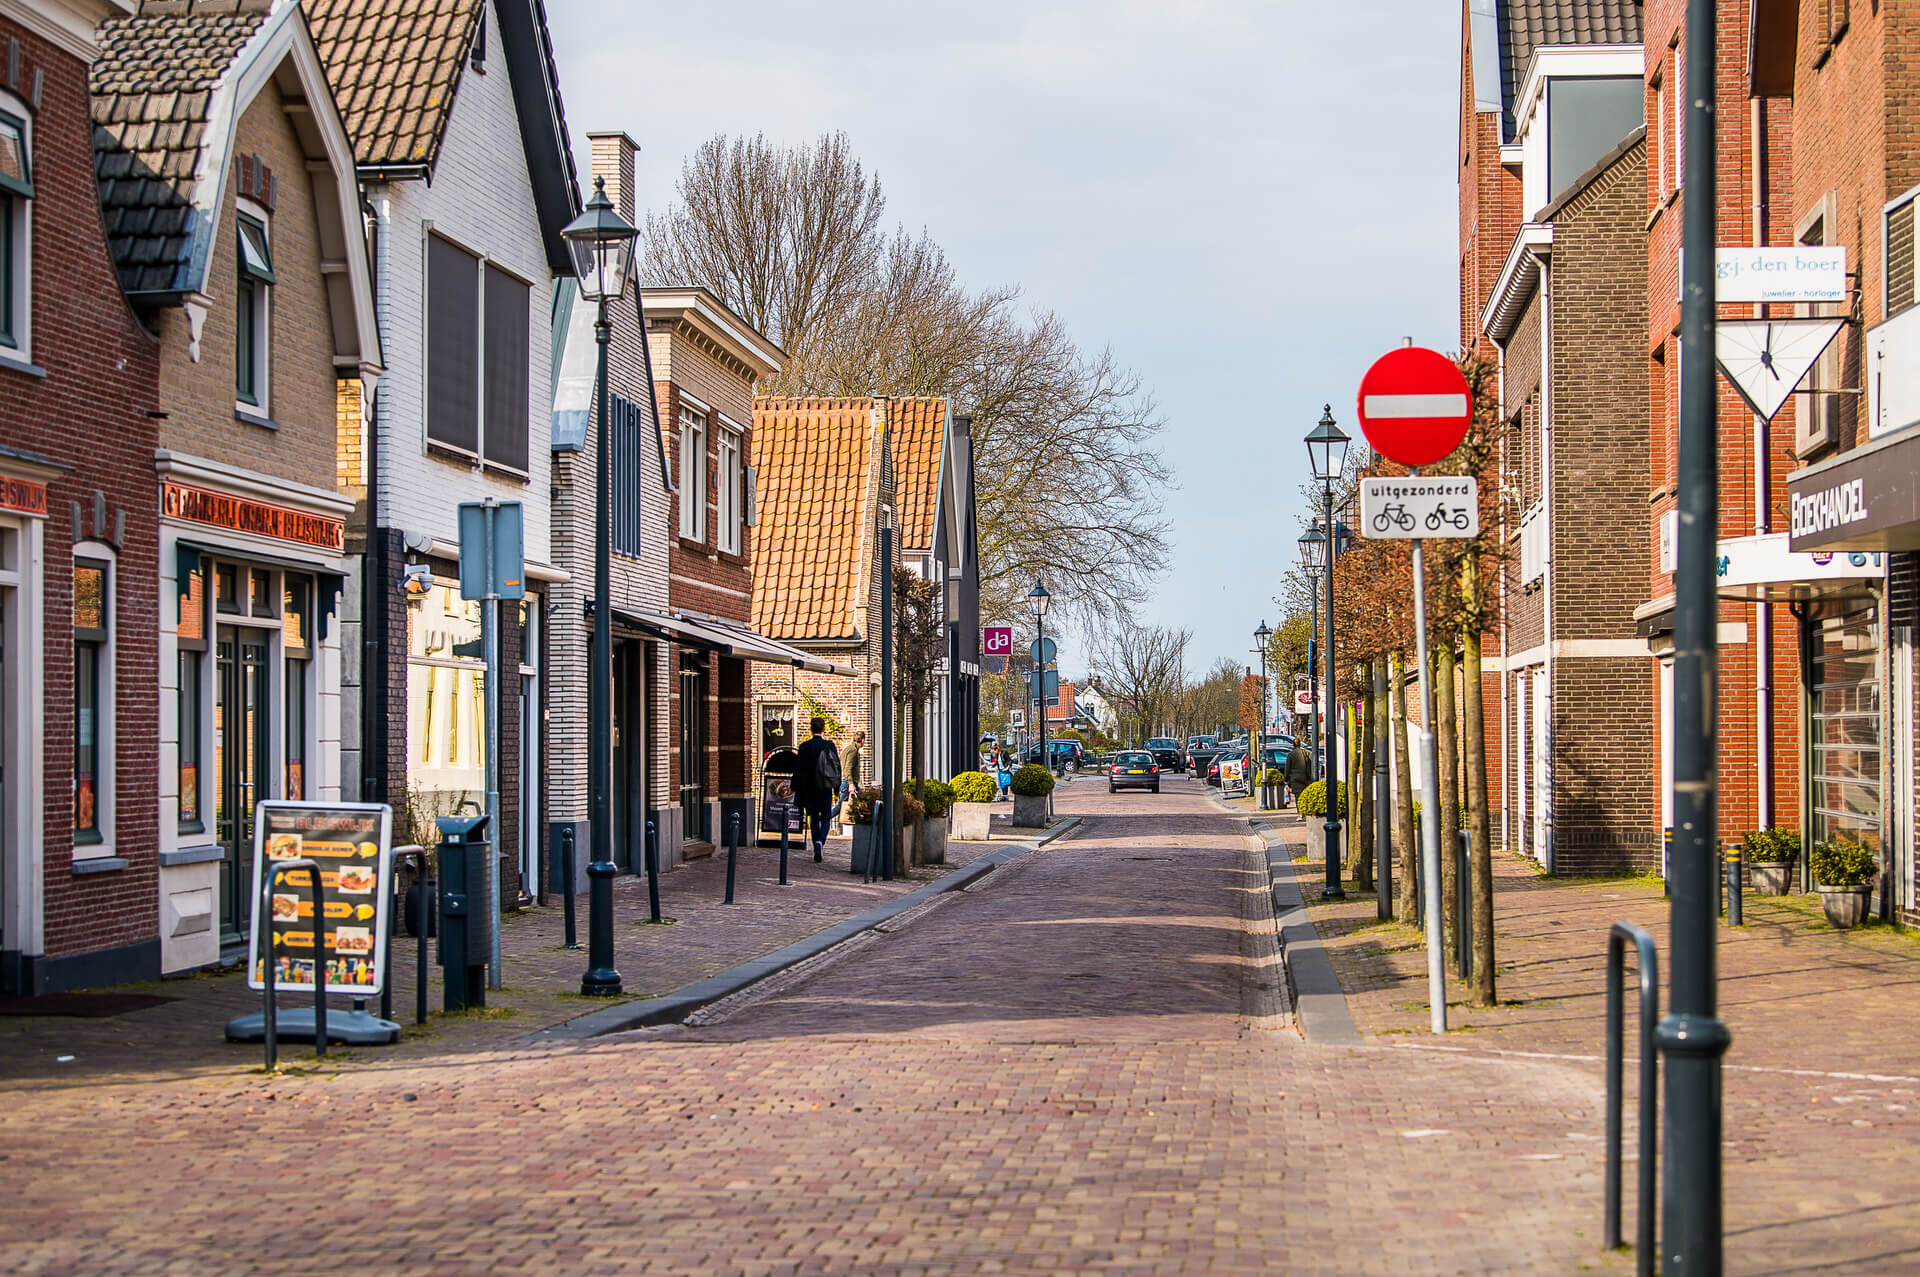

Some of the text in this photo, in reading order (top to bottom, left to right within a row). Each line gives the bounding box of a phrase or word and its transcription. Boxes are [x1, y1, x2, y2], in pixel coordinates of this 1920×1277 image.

[1751, 256, 1788, 272] den
[1795, 256, 1840, 272] boer
[1761, 288, 1797, 299] juwelier
[1804, 289, 1841, 299] horloger
[1371, 484, 1469, 499] uitgezonderd
[987, 631, 1009, 650] da
[296, 815, 376, 833] BLEISWIJK
